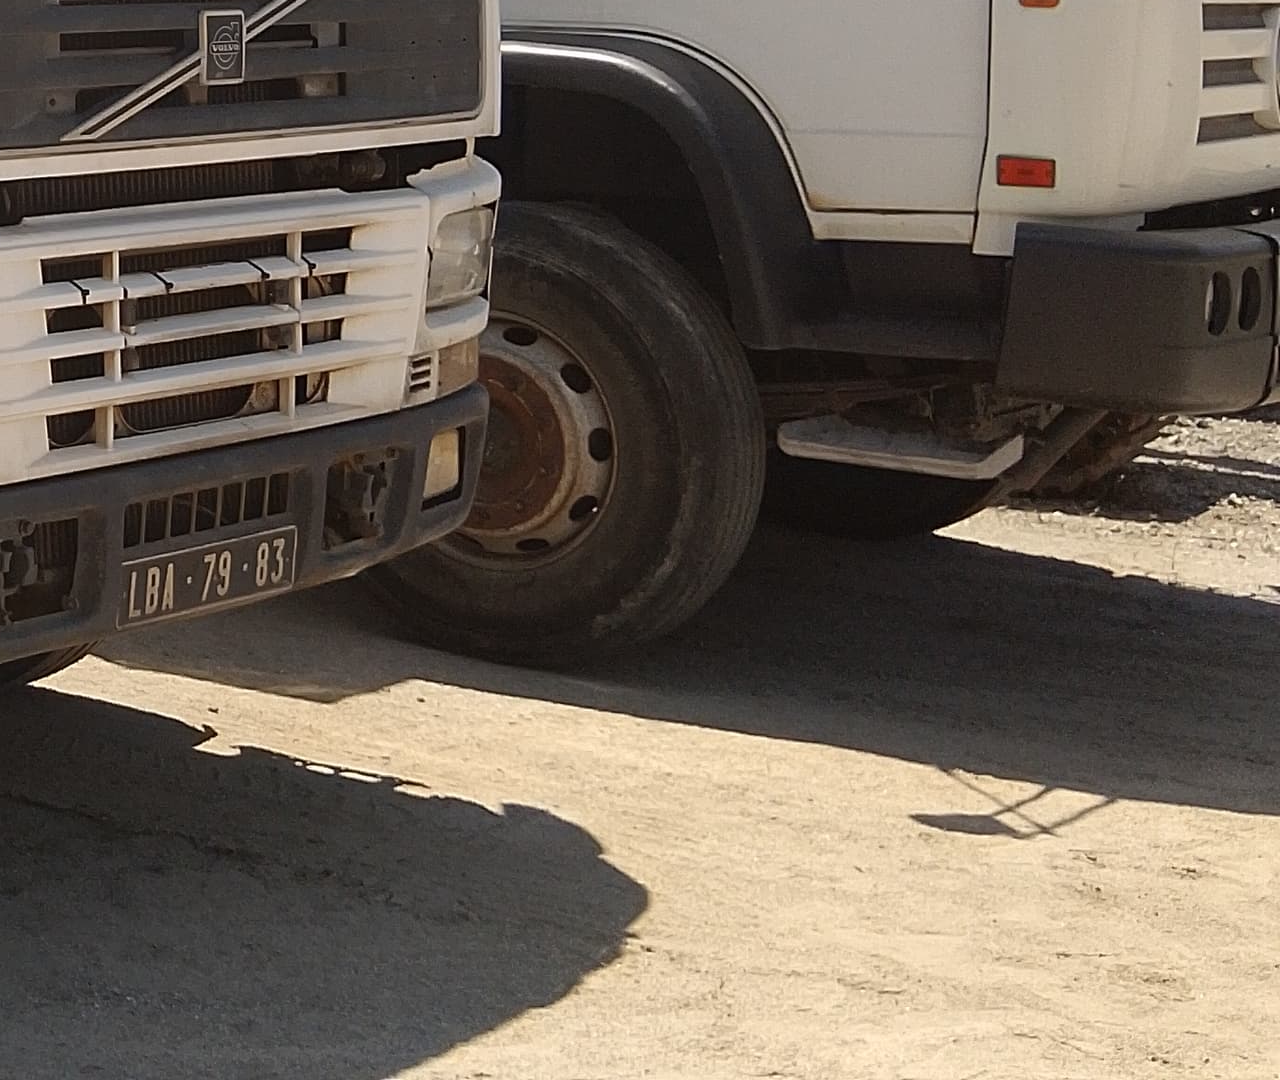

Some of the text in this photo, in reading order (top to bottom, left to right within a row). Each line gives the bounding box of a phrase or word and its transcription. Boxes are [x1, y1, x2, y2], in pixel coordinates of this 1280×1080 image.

[211, 43, 241, 52] VOLVO
[128, 537, 287, 620] LBA 79 83
